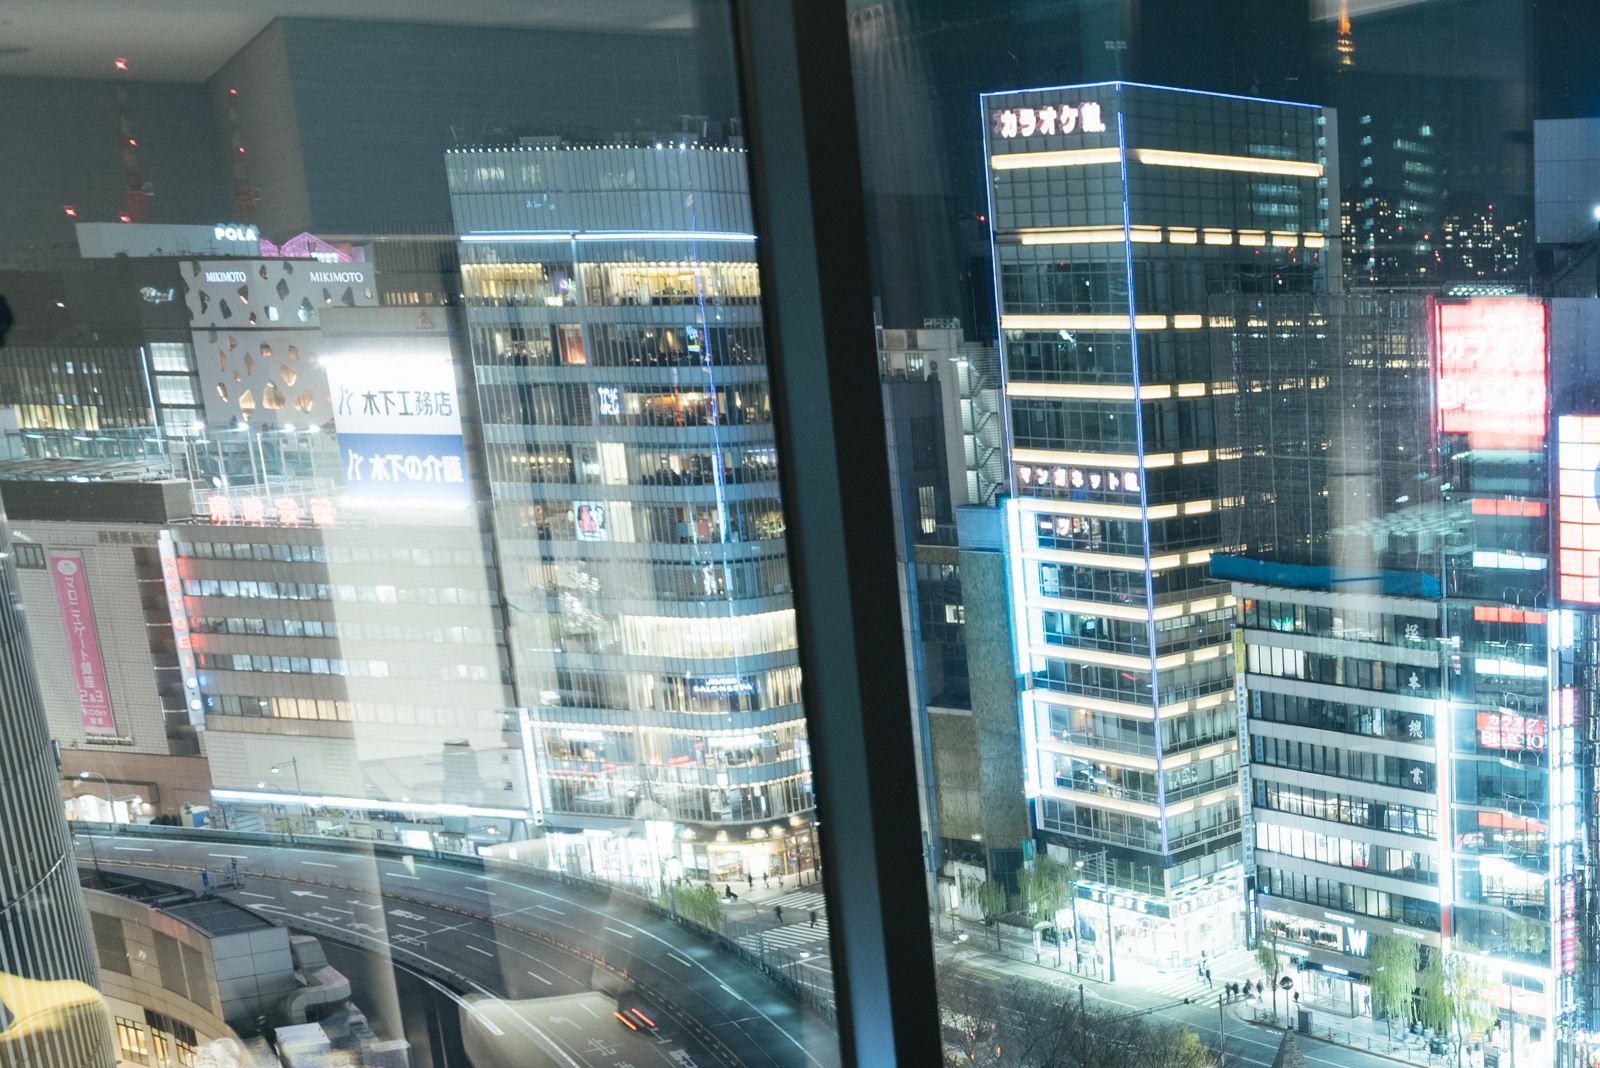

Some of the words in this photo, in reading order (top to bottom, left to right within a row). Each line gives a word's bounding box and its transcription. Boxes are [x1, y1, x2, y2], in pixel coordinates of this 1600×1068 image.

[214, 227, 258, 242] POLA
[206, 271, 247, 283] MIKIMOTO
[310, 271, 364, 283] MIKIMOTO
[361, 390, 453, 417] 木下工務店
